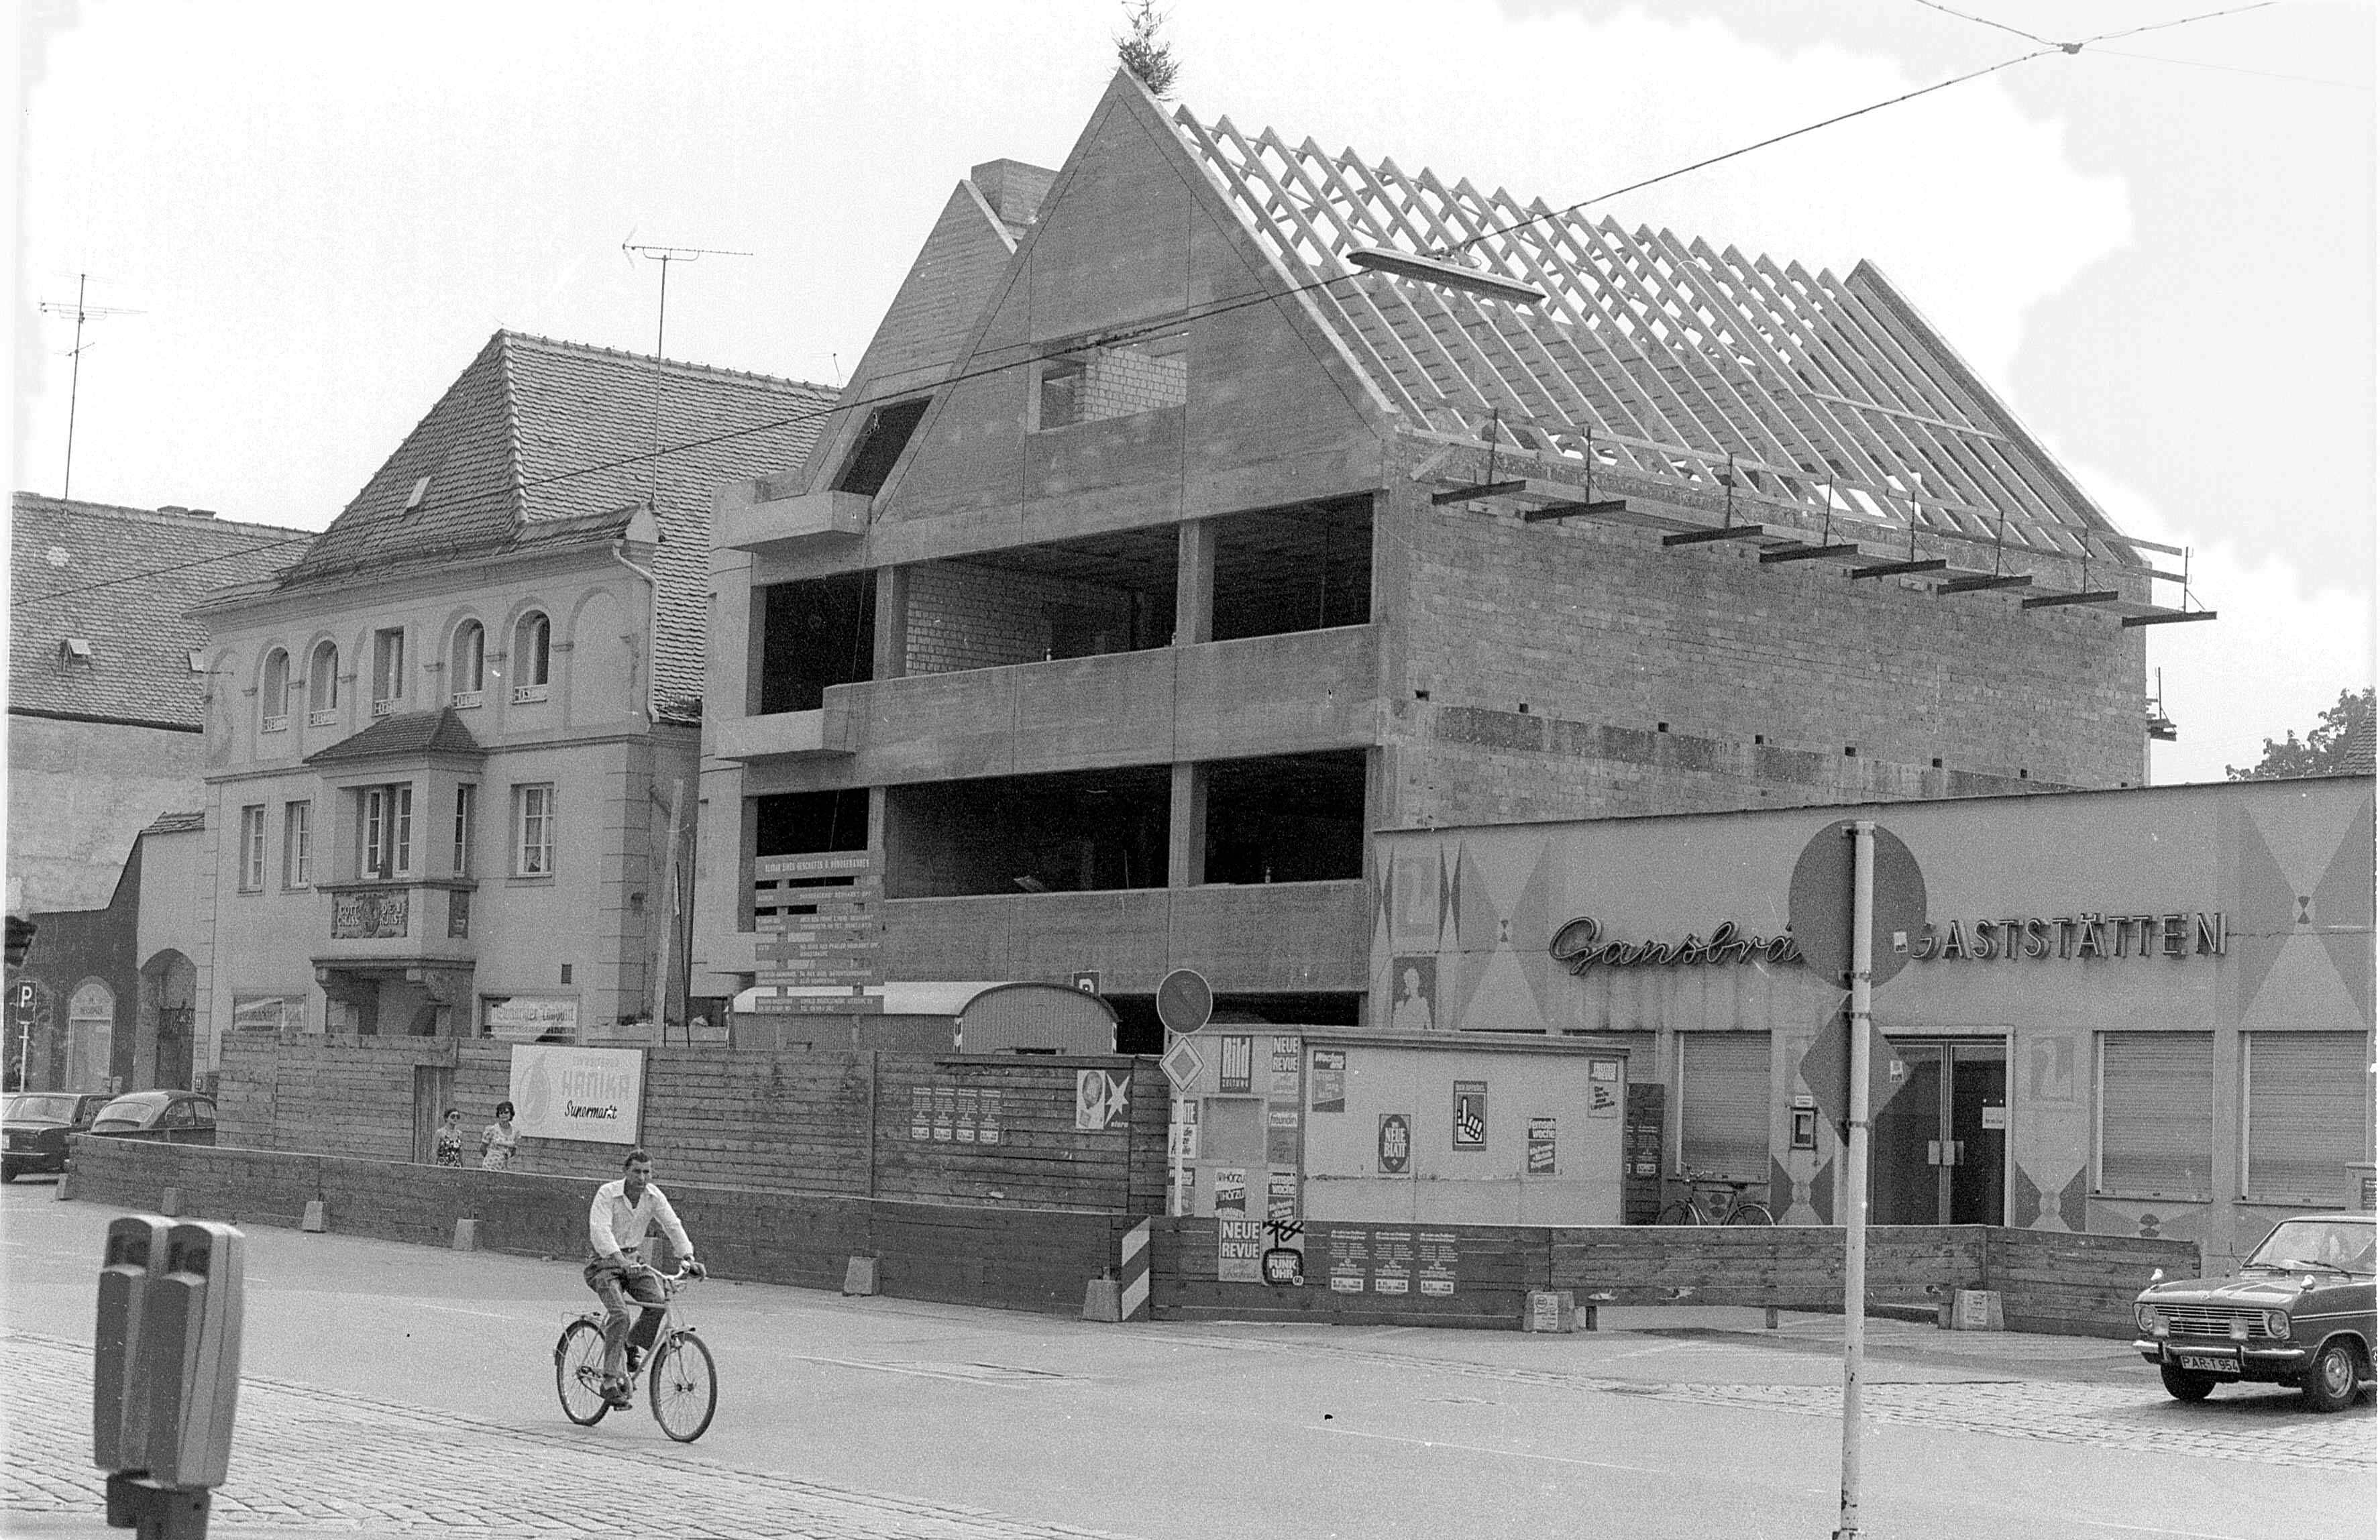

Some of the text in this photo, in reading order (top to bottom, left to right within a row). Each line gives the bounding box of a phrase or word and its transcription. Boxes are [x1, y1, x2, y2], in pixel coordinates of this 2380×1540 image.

[1549, 916, 1810, 975] Gansbrä
[21, 985, 33, 1008] P
[1273, 1036, 1298, 1054] NEUE
[1222, 1037, 1250, 1079] Bild
[1272, 1056, 1298, 1072] REVUE
[564, 1099, 618, 1119] Supermarkt
[1171, 1101, 1196, 1123] BTE
[1385, 1128, 1406, 1142] NEUE
[1383, 1142, 1407, 1158] BLATT
[1222, 1221, 1260, 1239] NEUE
[1221, 1242, 1259, 1258] REVUE
[1268, 1259, 1297, 1270] FUNK
[1272, 1268, 1294, 1279] UHR
